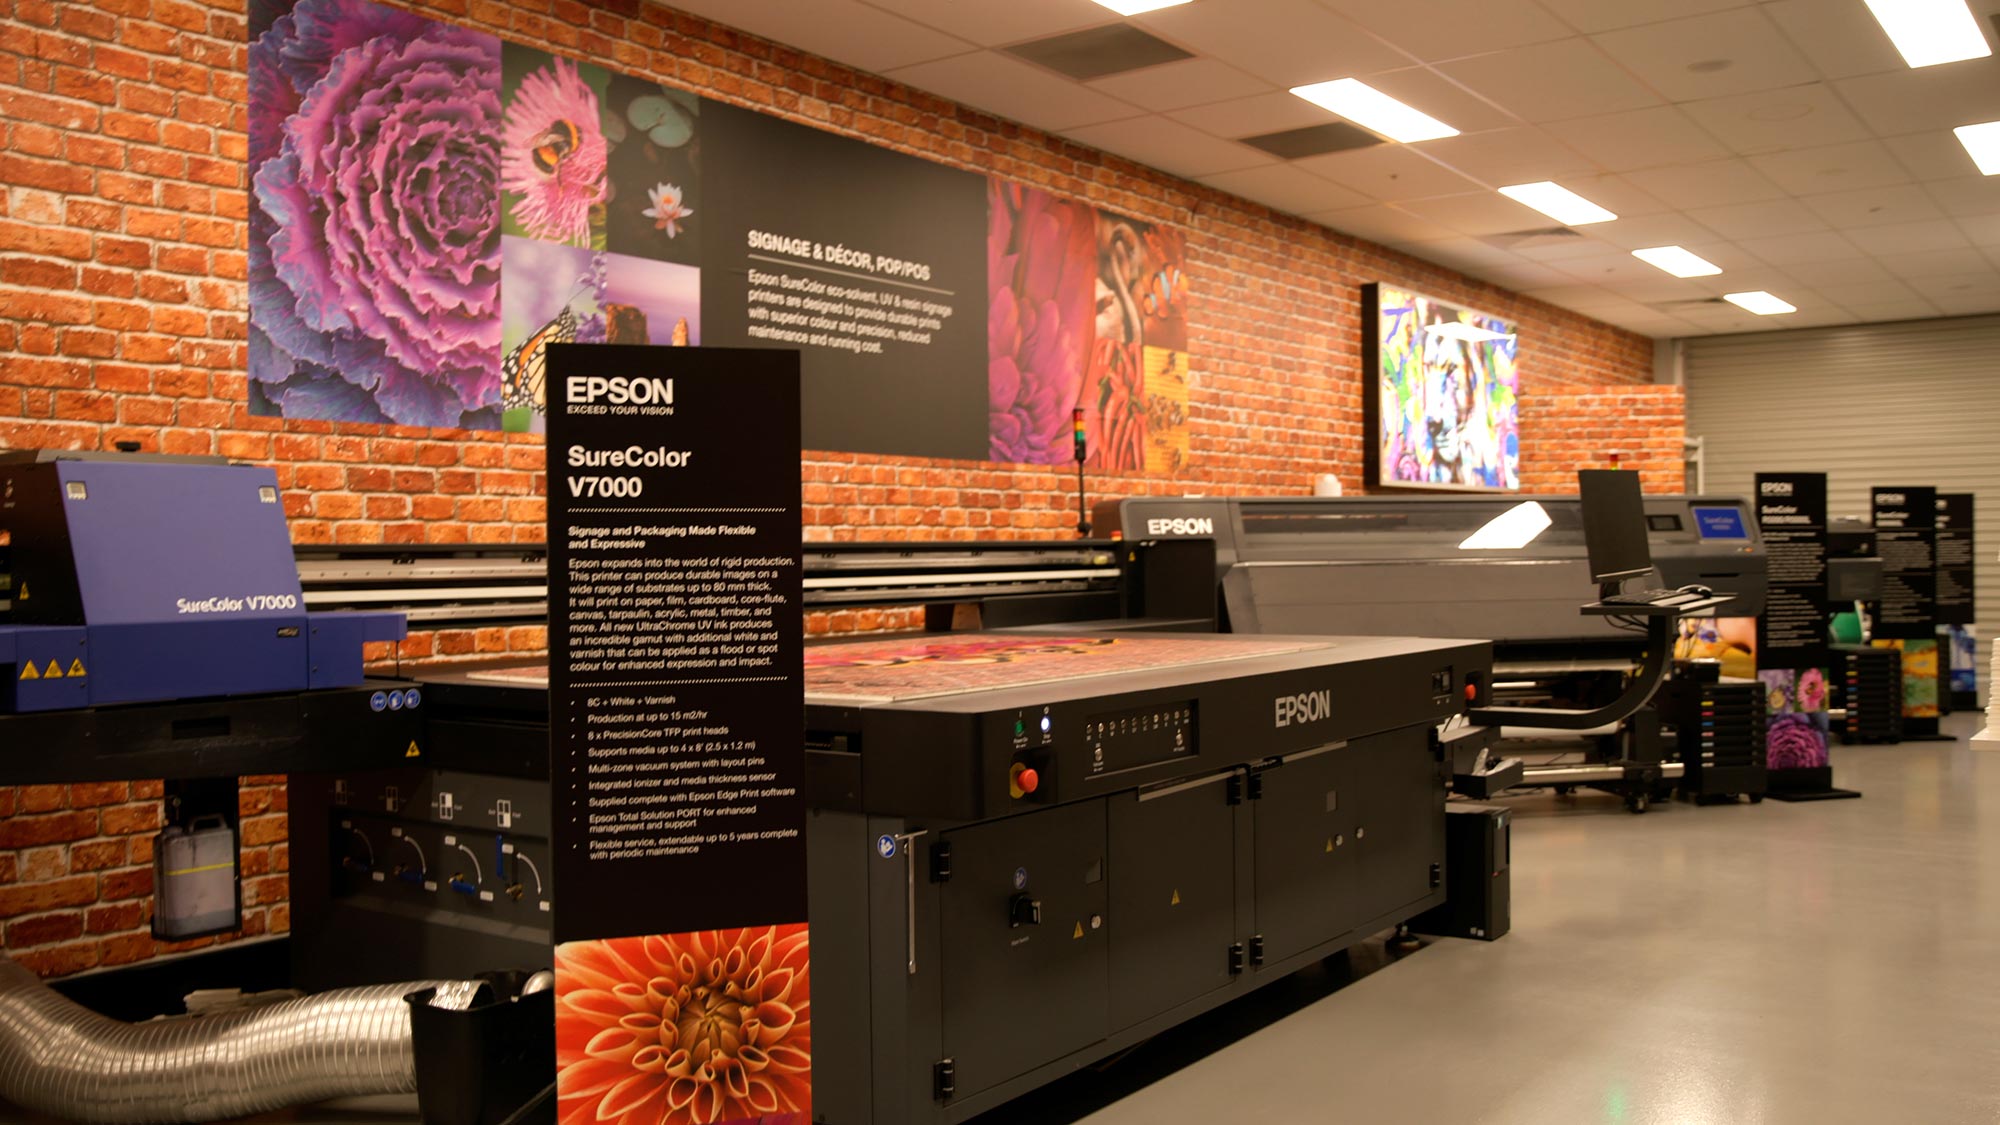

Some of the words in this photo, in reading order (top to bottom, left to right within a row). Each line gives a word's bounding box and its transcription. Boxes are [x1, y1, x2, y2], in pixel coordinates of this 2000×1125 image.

[748, 230, 811, 257] SIGNAGE
[812, 243, 823, 260] &
[825, 245, 875, 271] DÉCOR,
[876, 256, 931, 280] POP/POS
[748, 269, 780, 286] Epson
[780, 274, 826, 294] SureColor
[826, 286, 879, 304] eco-solvent,
[879, 293, 894, 306] UV
[921, 302, 953, 318] signage
[748, 289, 785, 305] printers
[786, 295, 802, 308] are
[802, 297, 844, 314] designed
[854, 307, 888, 321] provide
[886, 311, 919, 326] durable
[917, 314, 942, 330] prints
[748, 307, 770, 320] with
[770, 311, 809, 325] superior
[809, 316, 838, 330] colour
[838, 321, 857, 333] and
[856, 324, 897, 339] precision,
[897, 330, 931, 344] reduced
[748, 325, 809, 343] maintenance
[809, 334, 828, 346] and
[827, 337, 862, 353] running
[860, 341, 883, 353] cost.
[567, 376, 674, 404] EPSON
[567, 405, 607, 414] EXCEED
[610, 406, 638, 415] YOUR
[640, 406, 674, 416] VISION
[568, 445, 692, 467] SureColor
[568, 477, 642, 498] V7000
[568, 526, 611, 538] Signage
[612, 526, 632, 536] and
[633, 525, 687, 537] Packaging
[688, 525, 717, 535] Made
[718, 525, 756, 535] Flexible
[1147, 518, 1213, 535] EPSON
[568, 539, 589, 549] and
[590, 538, 646, 550] Expressive
[568, 558, 600, 569] Epson
[601, 558, 643, 569] expands
[644, 558, 663, 567] into
[664, 558, 680, 567] the
[681, 557, 708, 567] world
[709, 556, 720, 567] of
[721, 557, 742, 568] rigid
[743, 557, 795, 567] production.
[569, 571, 590, 581] This
[591, 571, 623, 582] printer
[624, 572, 643, 581] can
[644, 571, 684, 581] produce
[685, 570, 721, 580] durable
[722, 570, 756, 581] images
[757, 570, 770, 579] on
[771, 570, 778, 578] a
[569, 584, 593, 594] wide
[594, 585, 622, 596] range
[623, 583, 634, 594] of
[635, 583, 686, 593] substrates
[686, 584, 700, 594] up
[701, 583, 712, 592] to
[713, 581, 726, 592] 80
[727, 583, 746, 591] mm
[747, 581, 772, 591] thick.
[177, 596, 243, 613] SureColor
[246, 594, 296, 610] V7000
[569, 597, 576, 607] It
[578, 597, 595, 607] will
[596, 597, 619, 608] print
[620, 598, 634, 606] on
[634, 597, 665, 607] paper,
[666, 595, 687, 605] film,
[688, 595, 739, 605] cardboard,
[740, 594, 787, 604] core-flute,
[569, 611, 607, 620] canvas,
[608, 609, 653, 620] tarpaulin,
[654, 608, 688, 620] acrylic,
[690, 607, 719, 617] metal,
[720, 607, 752, 617] timber,
[754, 606, 772, 616] and
[569, 624, 597, 633] more.
[599, 622, 612, 632] All
[613, 623, 634, 632] new
[636, 620, 696, 631] UltraChrome
[697, 620, 712, 630] UV
[713, 619, 728, 629] ink
[729, 619, 773, 630] produces
[569, 637, 582, 646] an
[584, 635, 631, 645] incredible
[632, 634, 663, 646] gamut
[664, 633, 685, 643] with
[686, 632, 732, 643] additional
[733, 632, 759, 641] white
[760, 631, 778, 641] and
[569, 648, 605, 658] varnish
[606, 648, 626, 657] that
[627, 648, 646, 657] can
[647, 646, 661, 656] be
[662, 646, 697, 657] applied
[698, 646, 711, 655] as
[712, 646, 719, 655] a
[720, 644, 744, 654] flood
[745, 645, 756, 654] or
[757, 644, 778, 654] spot
[569, 661, 601, 671] colour
[602, 660, 616, 670] for
[617, 660, 665, 670] enhanced
[666, 659, 717, 669] expression
[718, 657, 737, 667] and
[738, 656, 772, 667] impact.
[1275, 689, 1330, 728] EPSON
[588, 764, 634, 773] Multi-zone
[635, 762, 669, 771] vacuum
[670, 760, 700, 771] system
[701, 759, 720, 768] with
[720, 758, 746, 768] layout
[747, 757, 765, 767] pins
[588, 780, 632, 791] Integrated
[633, 779, 662, 788] ionizer
[663, 777, 680, 786] and
[680, 776, 707, 785] media
[708, 774, 748, 783] thickness
[748, 773, 776, 782] sensor
[588, 796, 627, 807] Supplied
[628, 794, 668, 805] complete
[669, 793, 688, 802] with
[688, 792, 716, 802] Epson
[716, 790, 739, 800] Edge
[740, 789, 759, 798] Print
[760, 788, 796, 797] software
[589, 814, 617, 824] Epson
[618, 812, 639, 821] Total
[640, 811, 675, 819] Solution
[676, 808, 701, 818] PORT
[703, 807, 715, 816] for
[716, 805, 757, 815] enhanced
[589, 821, 645, 833] management
[646, 820, 663, 830] and
[664, 819, 697, 829] support
[589, 850, 608, 860] with
[609, 848, 644, 860] periodic
[645, 846, 700, 856] maintenance
